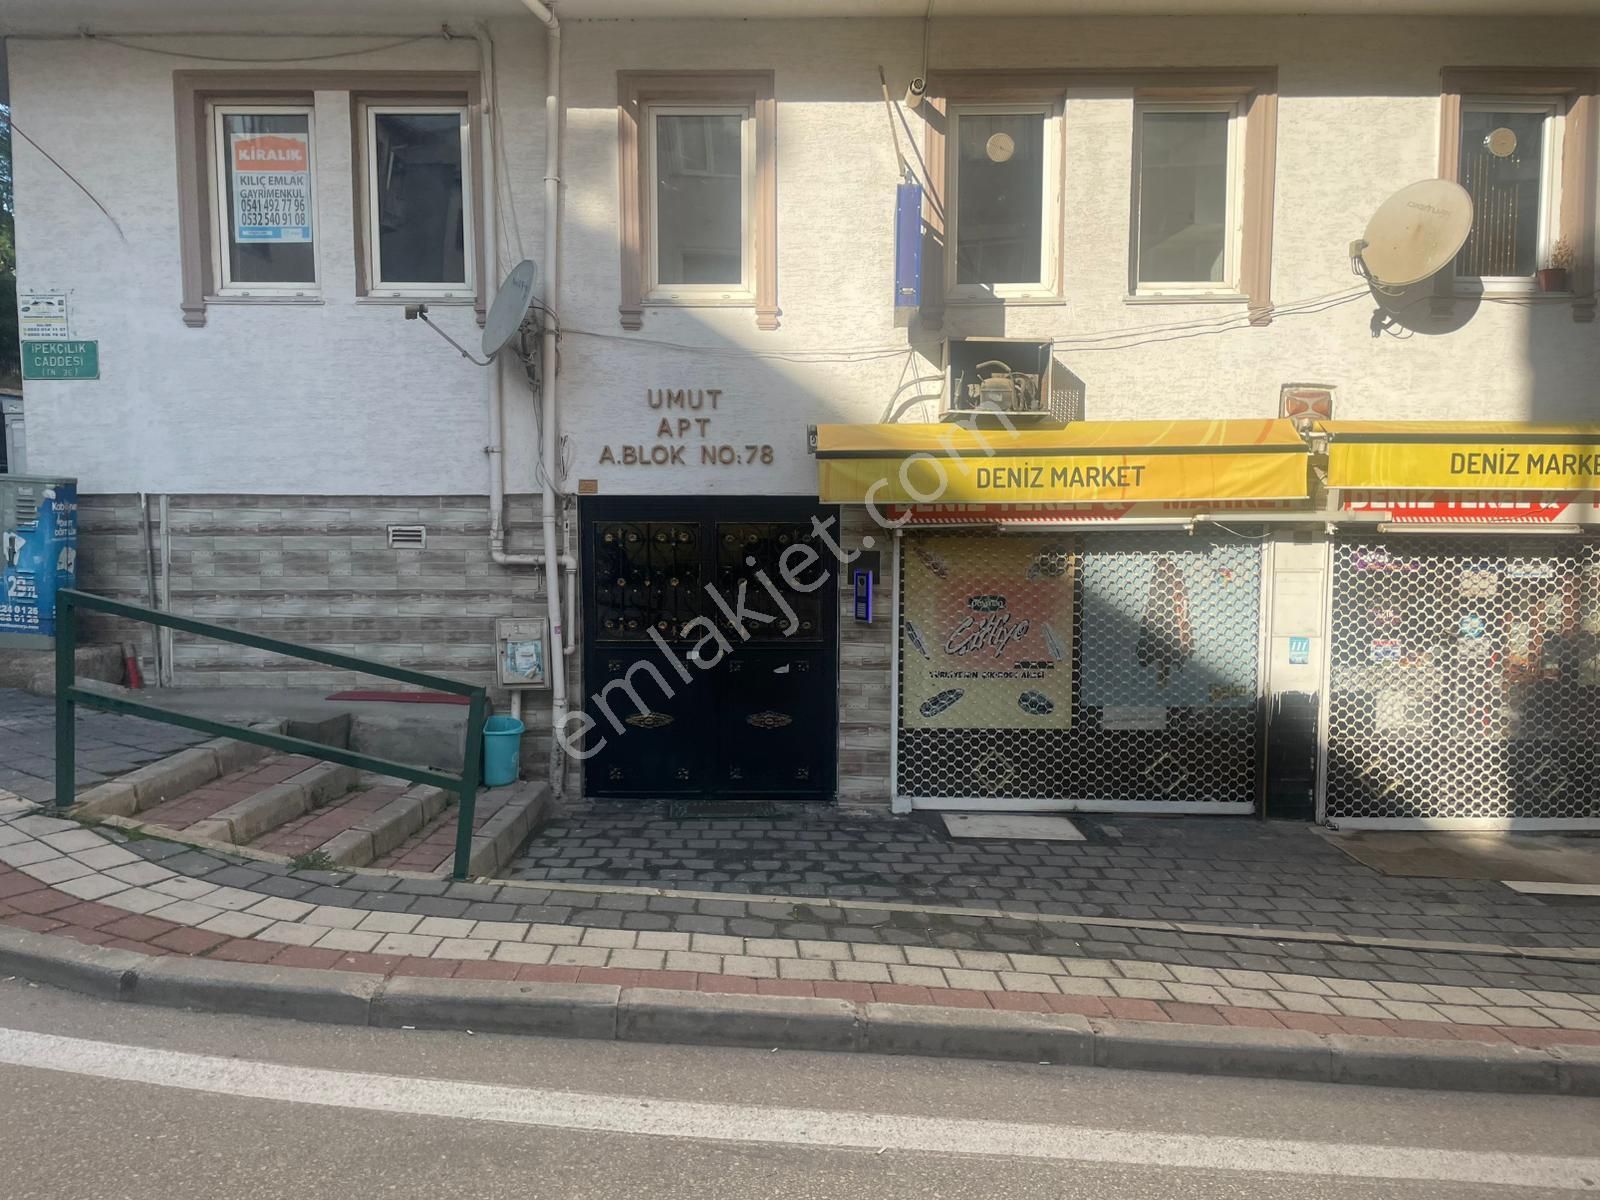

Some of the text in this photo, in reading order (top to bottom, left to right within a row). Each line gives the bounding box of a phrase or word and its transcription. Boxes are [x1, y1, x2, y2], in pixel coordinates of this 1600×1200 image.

[239, 147, 302, 160] KİRALIK
[240, 176, 304, 188] KILIÇ EMLAK
[240, 188, 304, 198] GAYRİMENKUL
[241, 199, 305, 212] 0541 492 77 96
[241, 212, 306, 226] 0532 540 91 08
[647, 388, 723, 410] UMUT
[656, 417, 712, 438] APT
[598, 444, 775, 466] A.BLOK NO:78
[1450, 448, 1520, 475] DENİZ
[976, 461, 1146, 489] DENİZ MARKET
